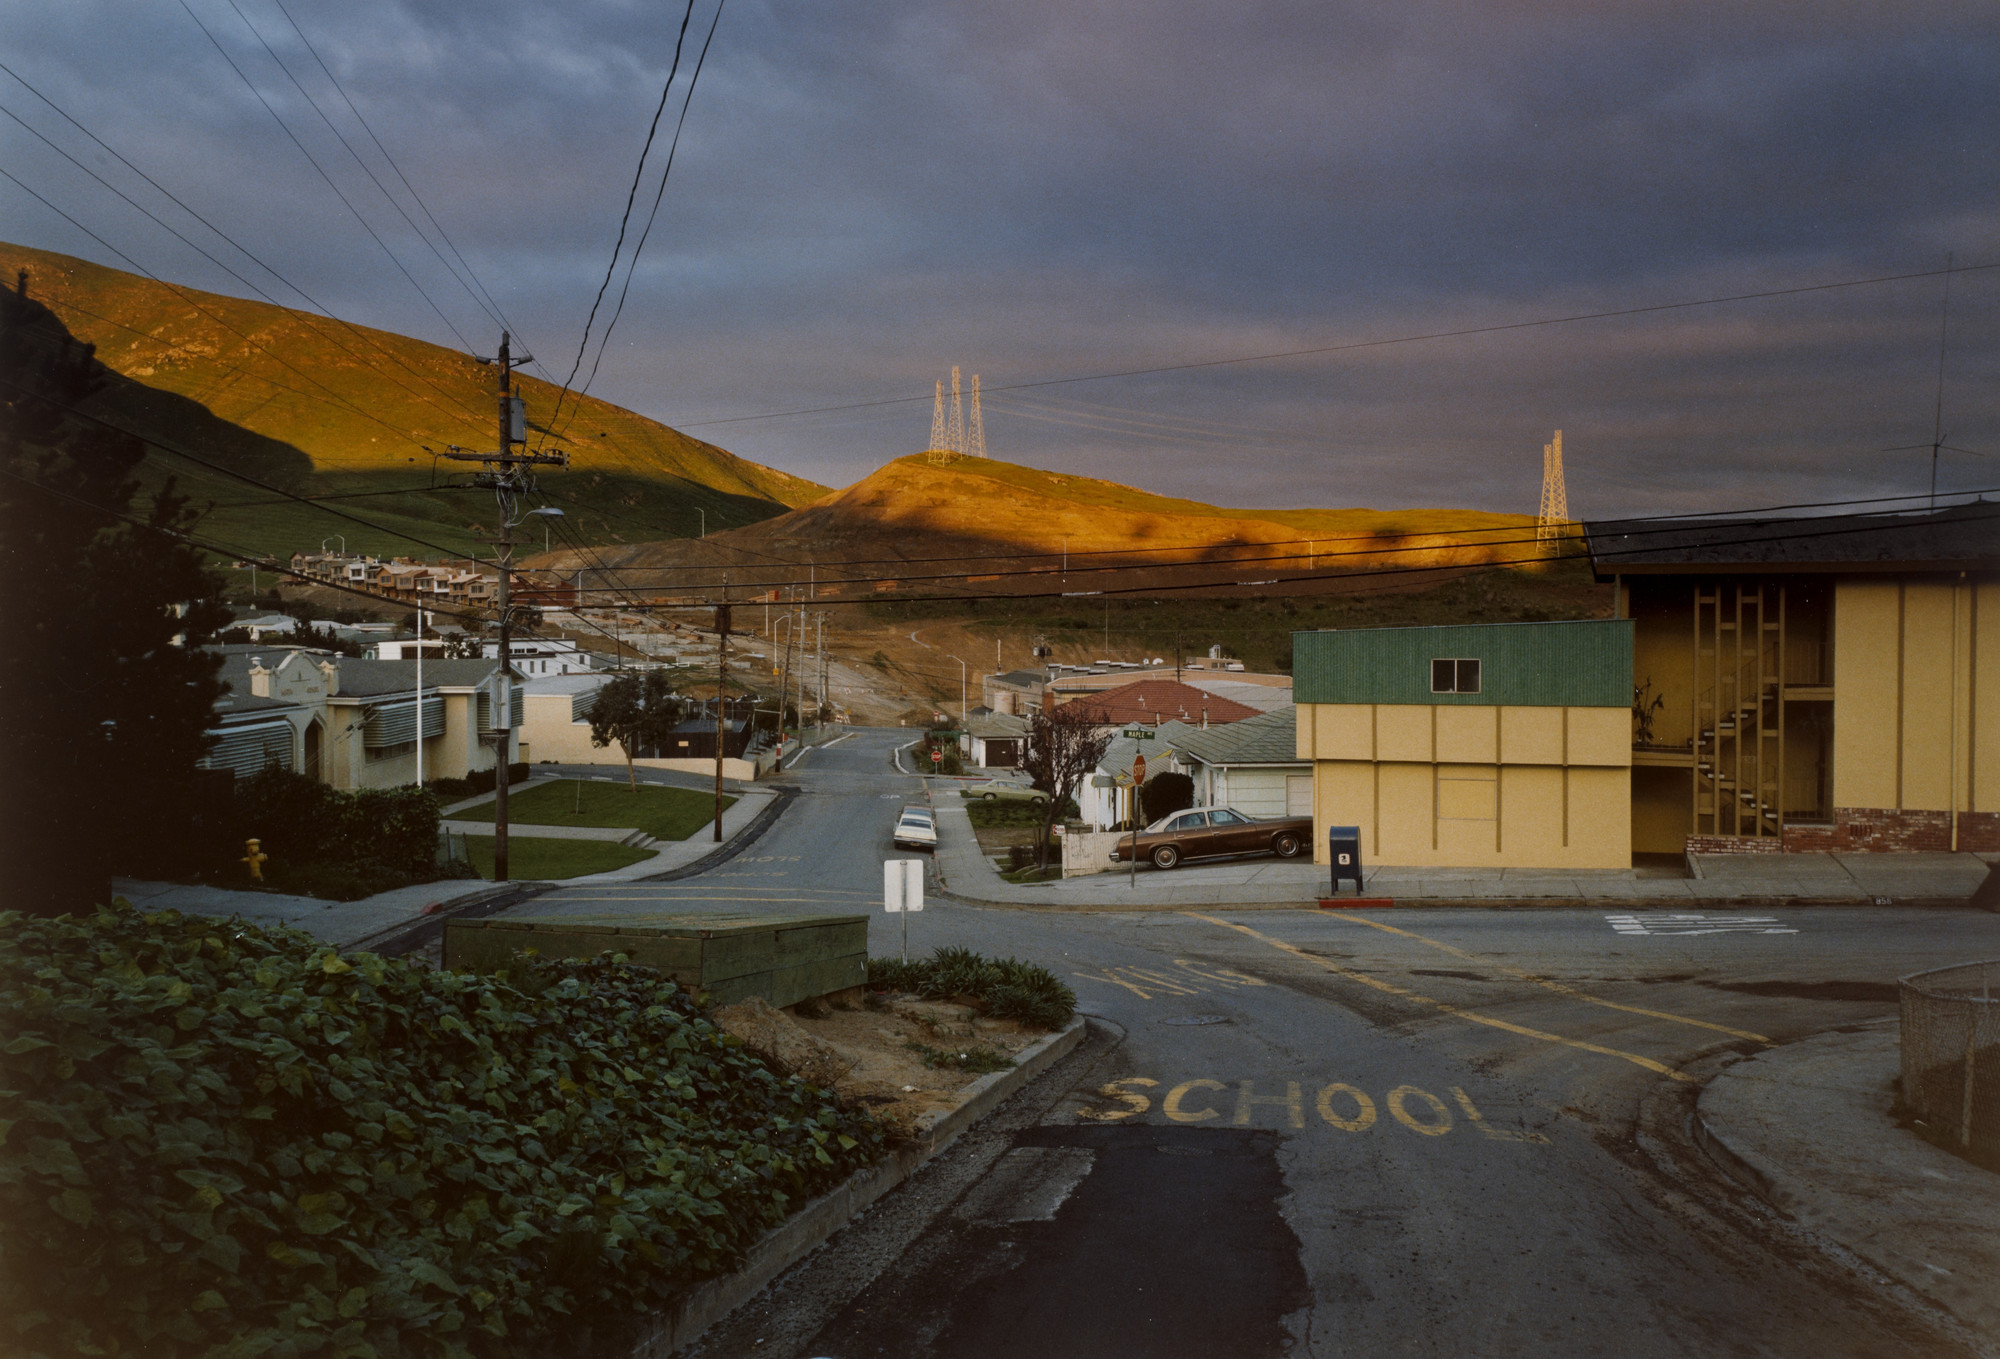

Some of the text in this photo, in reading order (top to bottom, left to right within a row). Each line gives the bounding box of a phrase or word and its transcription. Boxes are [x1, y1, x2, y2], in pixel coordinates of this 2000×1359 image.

[1128, 731, 1145, 739] MAPLE
[1133, 763, 1146, 777] STOP
[735, 855, 802, 863] SLOW
[1076, 1077, 1552, 1146] SCHOOL
